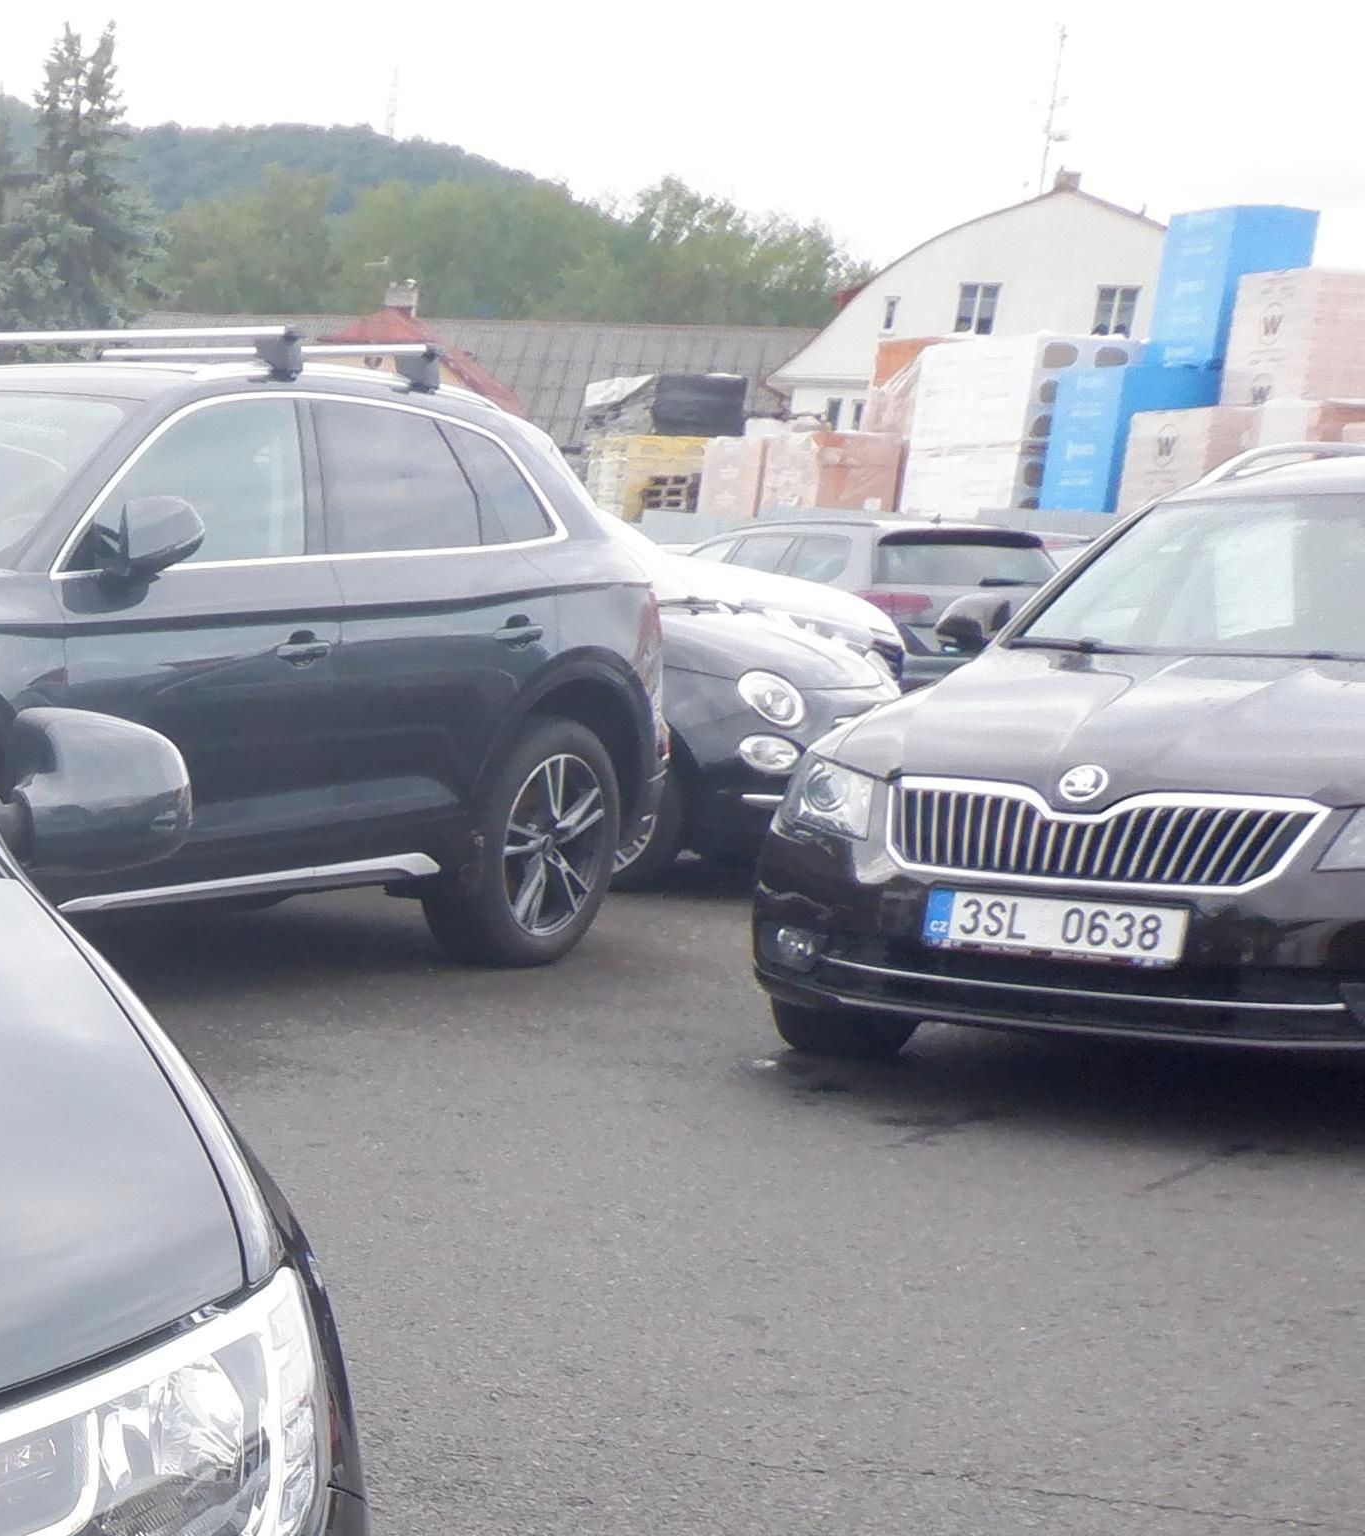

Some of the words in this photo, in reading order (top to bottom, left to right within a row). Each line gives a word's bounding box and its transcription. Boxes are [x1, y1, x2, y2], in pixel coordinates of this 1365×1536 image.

[929, 919, 949, 934] CZ
[958, 898, 1027, 941] 3SL
[1060, 906, 1163, 952] 0638
